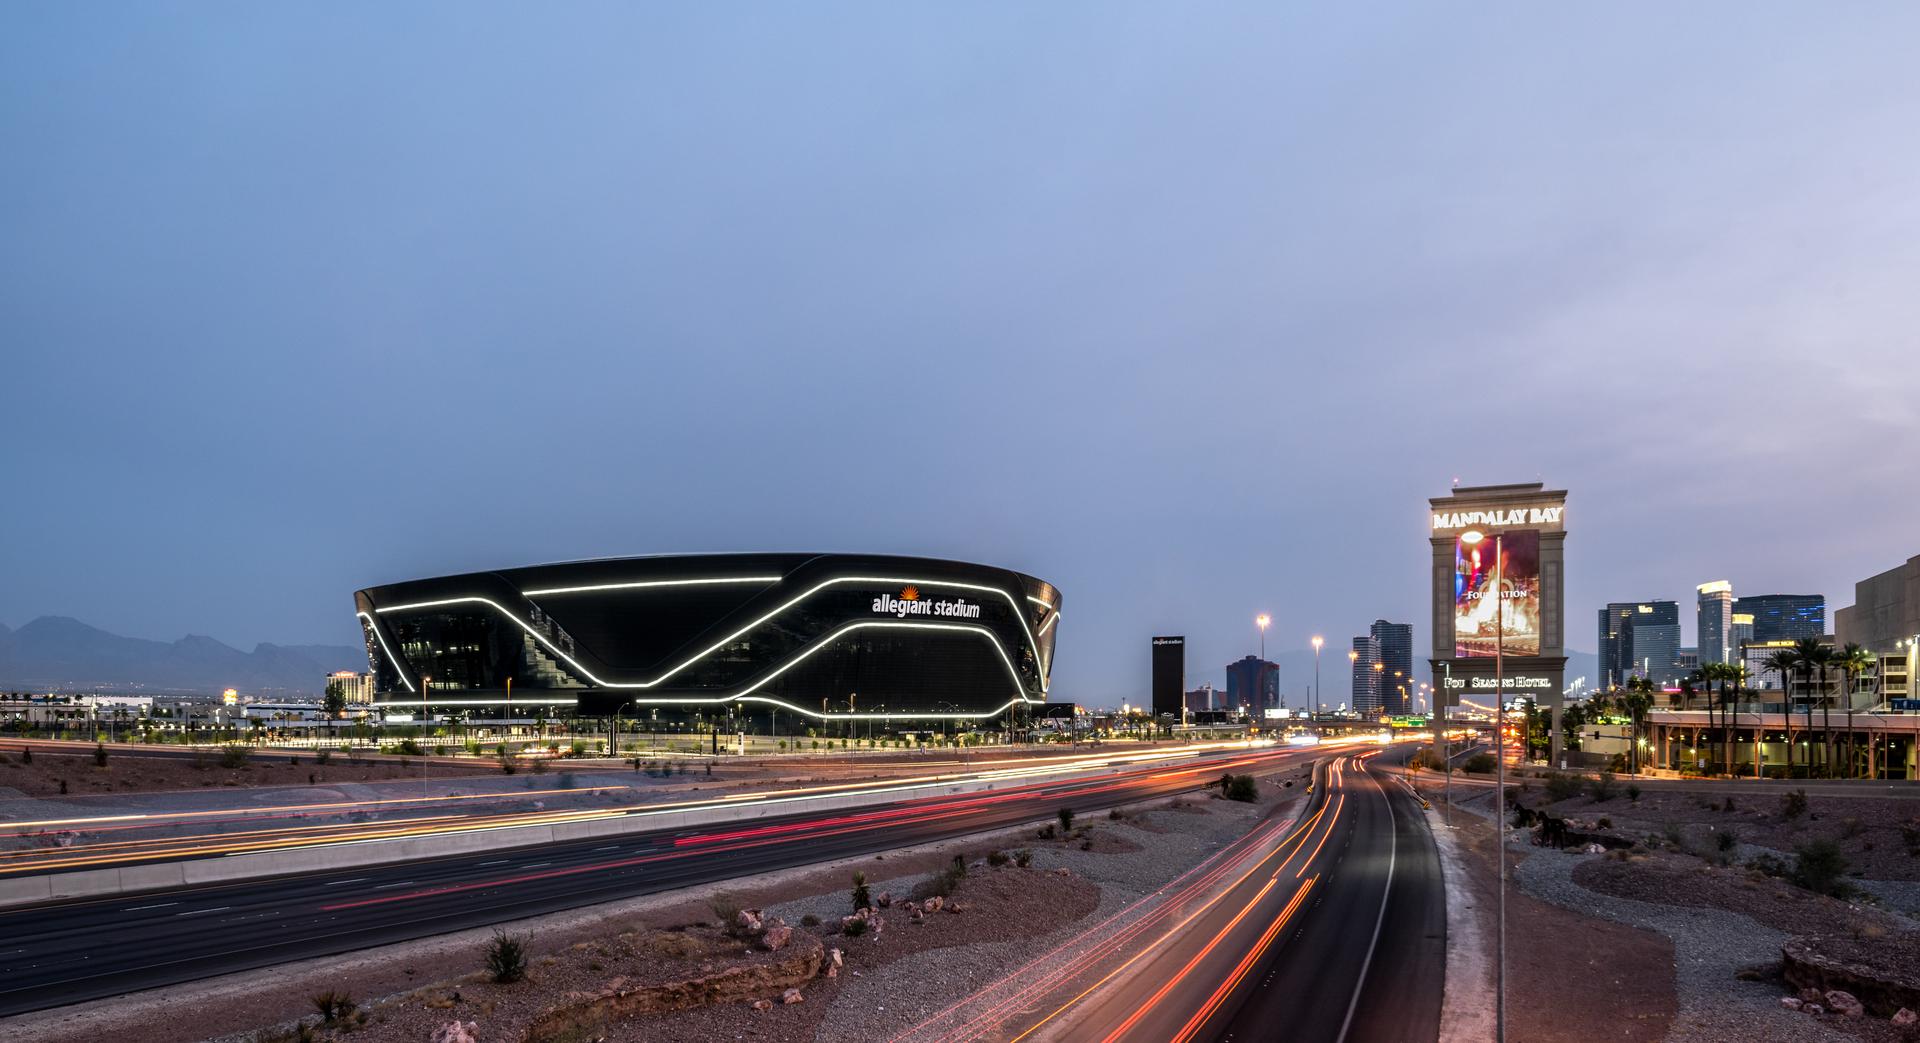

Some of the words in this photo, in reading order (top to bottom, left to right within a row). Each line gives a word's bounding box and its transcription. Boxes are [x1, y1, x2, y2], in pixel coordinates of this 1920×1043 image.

[1433, 509, 1528, 528] MANDALAY
[1530, 507, 1563, 523] BAY
[872, 593, 932, 618] allegiant
[933, 599, 980, 618] stadium
[1515, 676, 1552, 688] HOTEL
